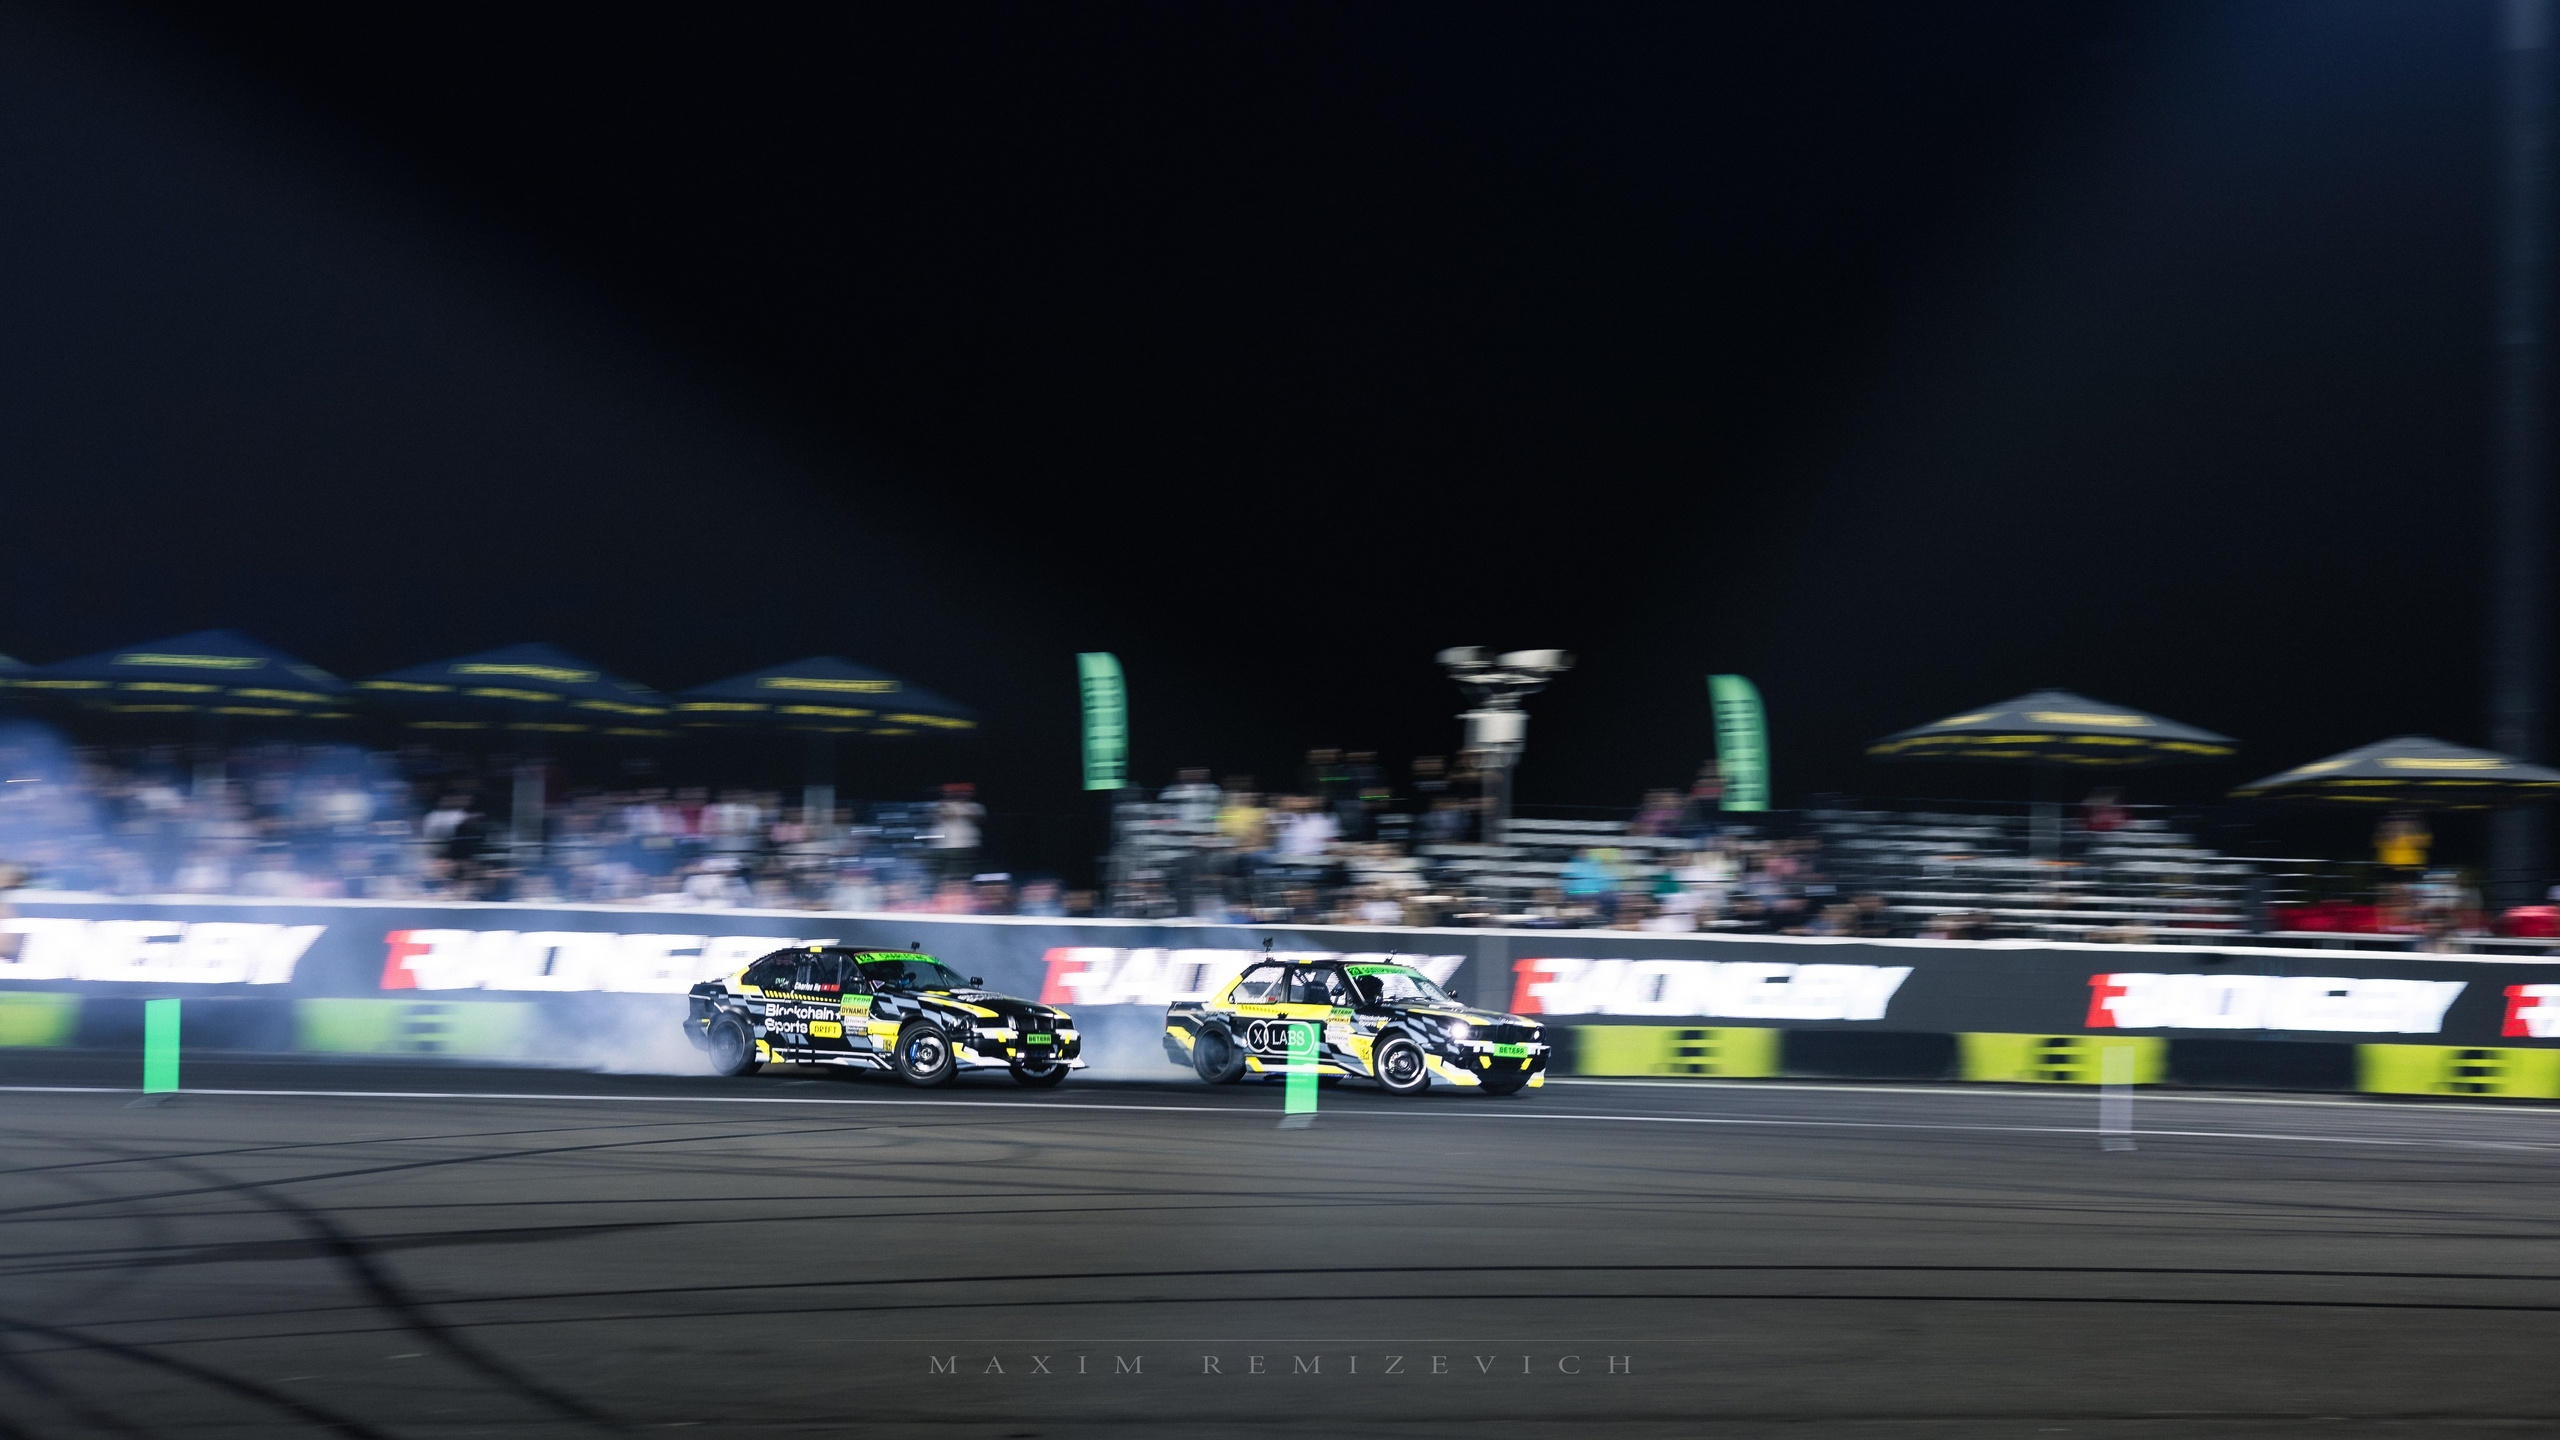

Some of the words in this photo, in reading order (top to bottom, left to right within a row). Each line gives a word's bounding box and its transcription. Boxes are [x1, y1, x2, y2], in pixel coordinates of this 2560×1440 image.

[765, 1003, 834, 1020] Blockchain
[764, 1018, 809, 1034] Sports
[814, 1024, 838, 1034] DRIFT
[1272, 1029, 1305, 1046] LABS
